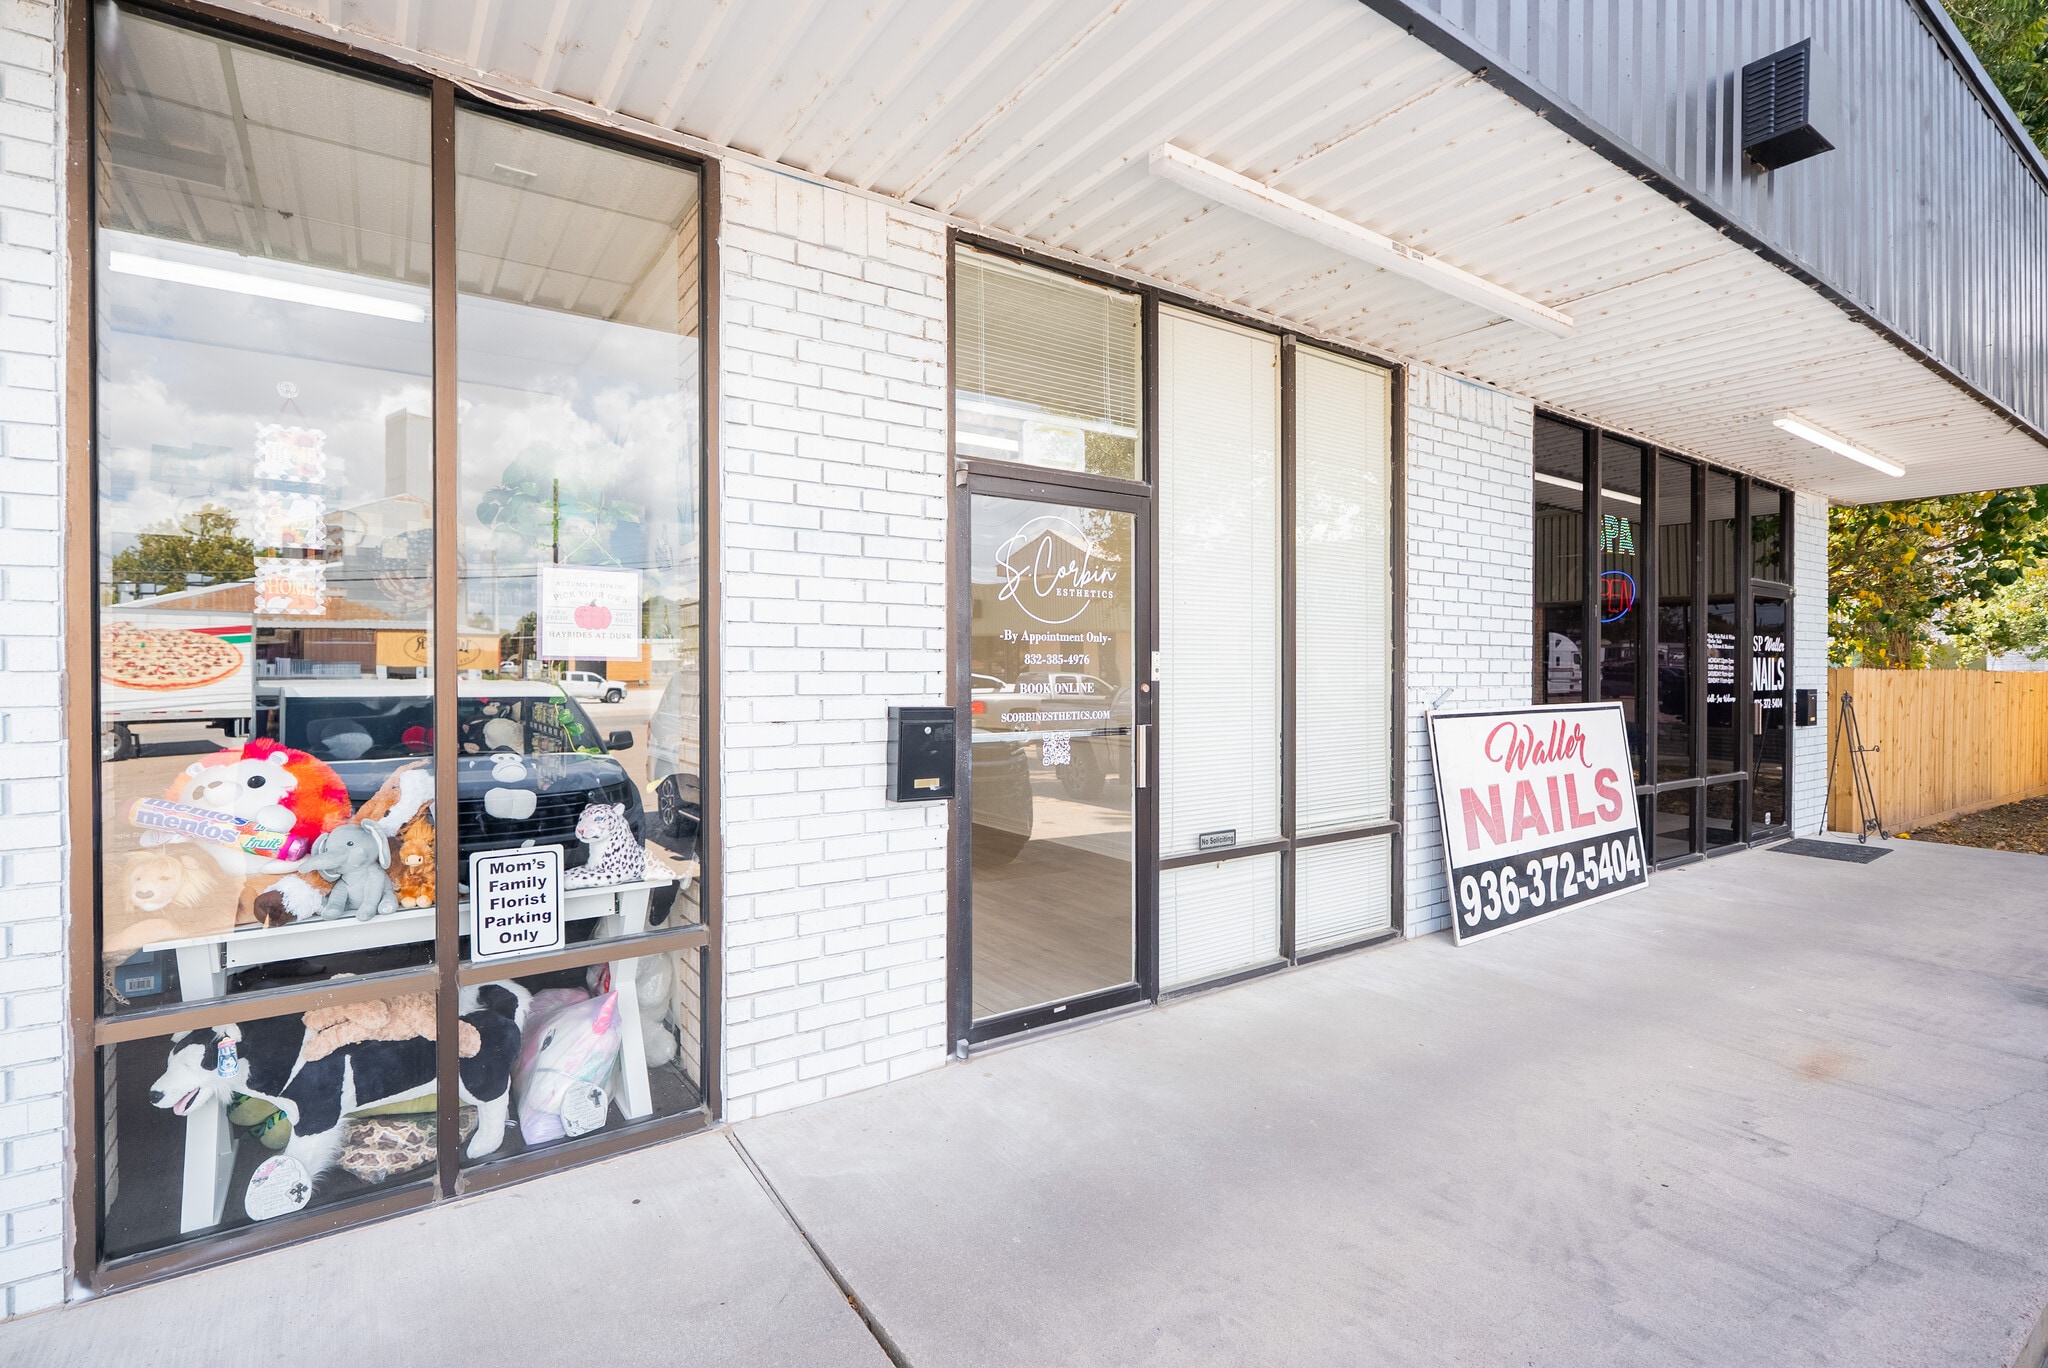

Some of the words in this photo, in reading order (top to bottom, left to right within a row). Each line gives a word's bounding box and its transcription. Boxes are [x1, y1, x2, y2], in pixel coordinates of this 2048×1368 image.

[1034, 535, 1117, 597] Corbin
[553, 591, 576, 601] PICK
[578, 590, 604, 599] YOUR
[607, 593, 628, 604] OWN
[1056, 588, 1114, 599] ESTHETICS
[1600, 578, 1633, 613] PEN
[549, 630, 593, 639] HAYRIDES
[609, 632, 632, 640] DUSK
[1021, 630, 1084, 644] Appointment
[1752, 635, 1763, 652] SP
[1024, 653, 1090, 665] 832-385-4976
[1752, 657, 1785, 691] NAILS
[1019, 682, 1052, 694] BOOK
[1054, 682, 1095, 694] ONLINE
[1001, 710, 1111, 723] SCORBINESTHETICS.COM
[1484, 718, 1593, 773] Waller
[143, 797, 249, 826] mentos
[1459, 767, 1623, 851] NAILS
[135, 809, 240, 844] mentos
[243, 836, 283, 850] fruit
[490, 858, 546, 875] Mom's
[489, 876, 547, 892] Family
[1459, 835, 1641, 927] 936-372-5404
[490, 892, 547, 910] Florist
[484, 911, 552, 929] Parking
[499, 929, 539, 944] Only
